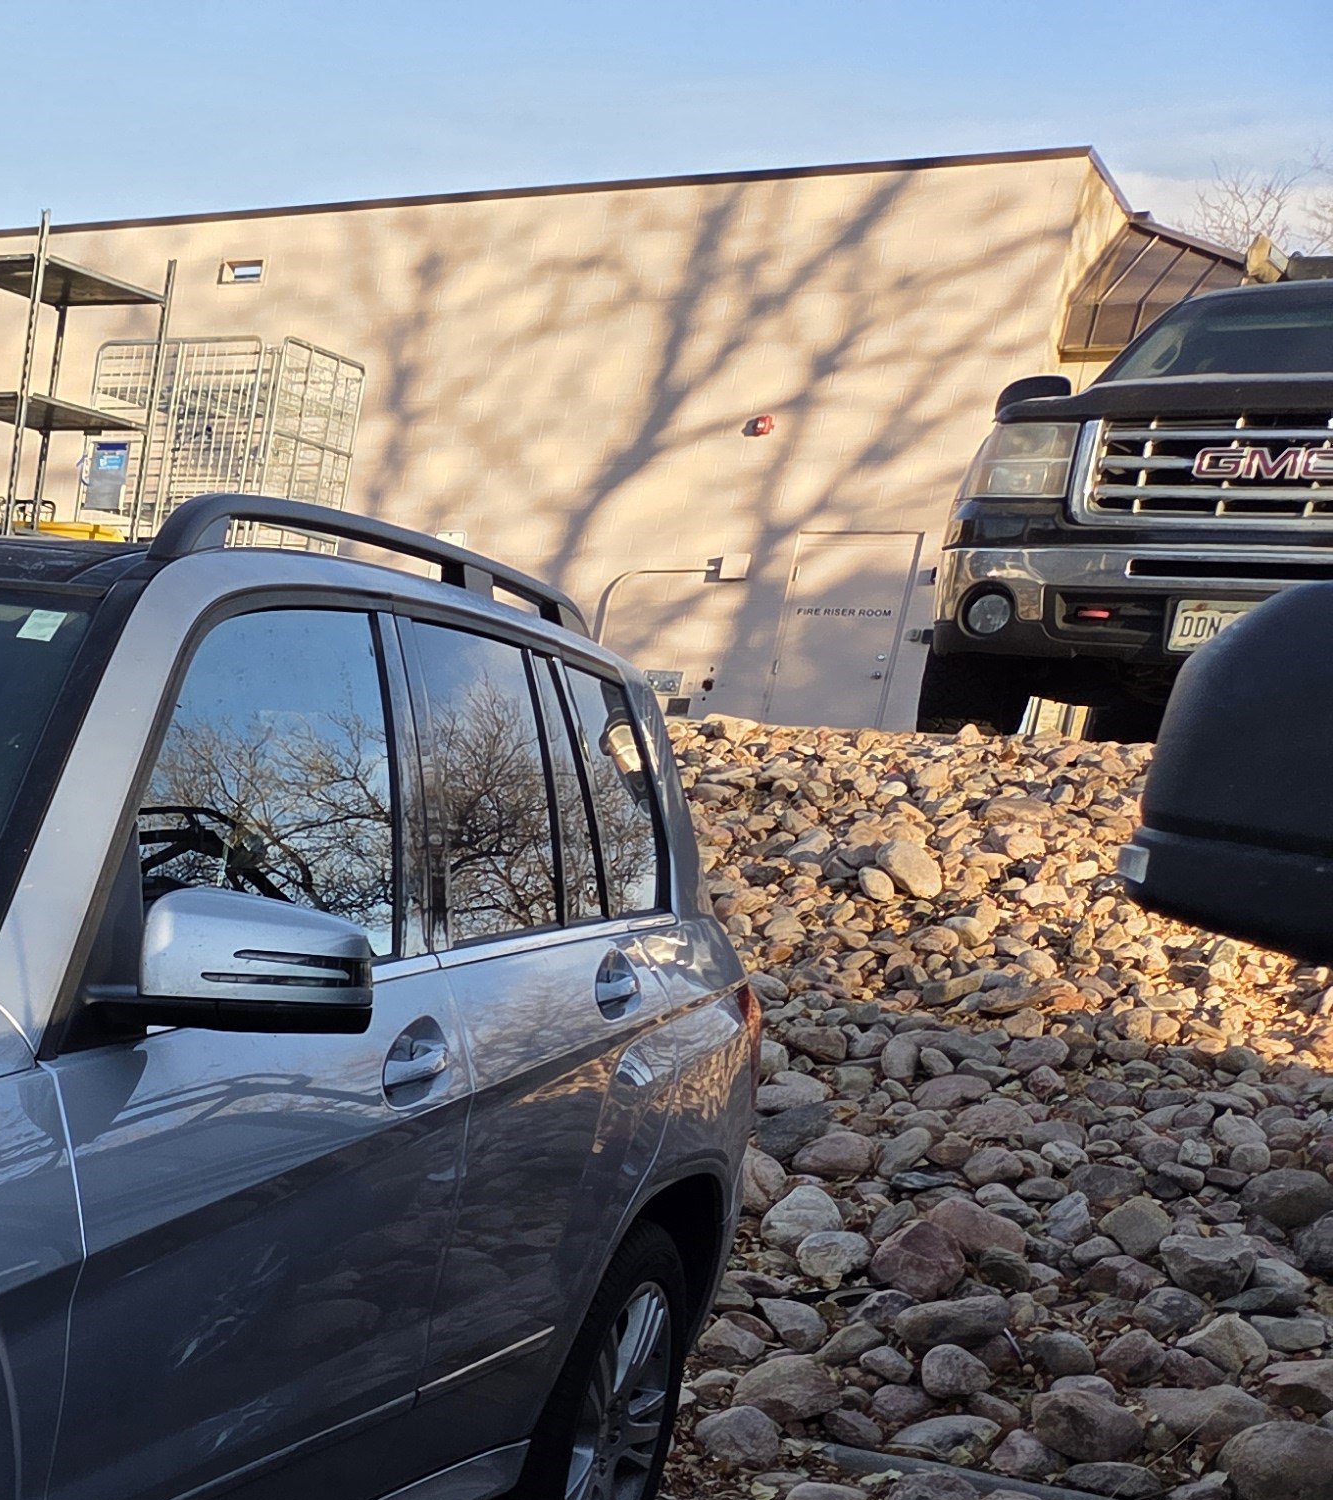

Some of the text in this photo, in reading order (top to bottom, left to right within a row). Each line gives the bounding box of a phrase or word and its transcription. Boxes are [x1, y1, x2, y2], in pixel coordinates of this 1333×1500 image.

[1193, 447, 1333, 479] GMC
[796, 607, 892, 618] FIRE RISER ROOM
